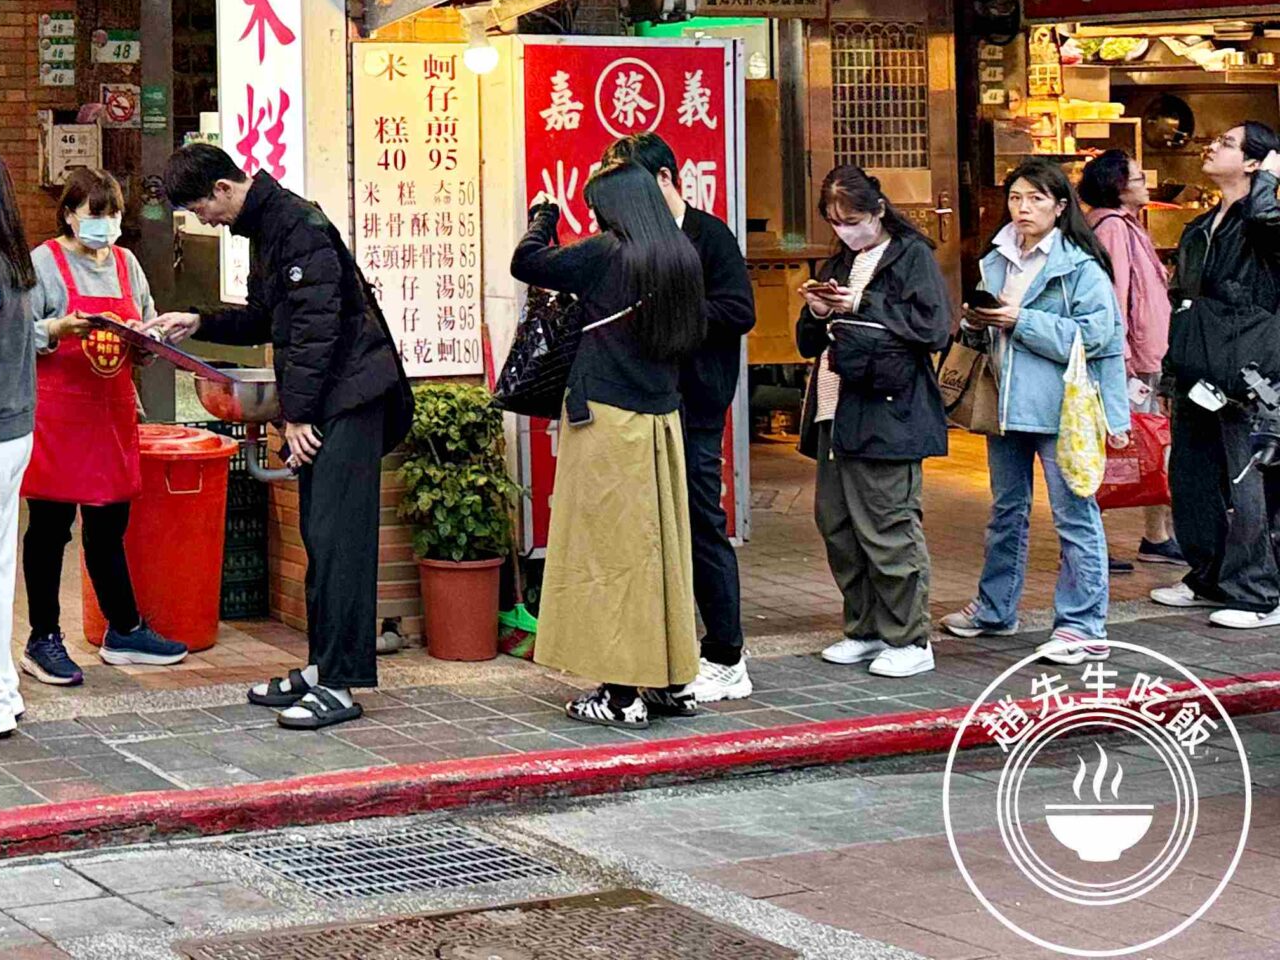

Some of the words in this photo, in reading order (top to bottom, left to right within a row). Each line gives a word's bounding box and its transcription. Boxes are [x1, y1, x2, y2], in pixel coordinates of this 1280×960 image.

[112, 44, 132, 59] 48
[423, 53, 459, 144] 蚵仔煎
[539, 70, 584, 131] 嘉
[677, 69, 718, 130] 義
[61, 134, 76, 144] 46
[377, 149, 407, 171] 40
[428, 149, 458, 171] 95
[458, 181, 475, 206] 50
[541, 158, 718, 234] 火飯
[363, 212, 453, 238] 排骨酥湯
[458, 212, 475, 238] 85
[365, 244, 454, 270] 菜頭排骨湯
[459, 243, 476, 269] 85
[458, 274, 474, 300] 95
[459, 305, 474, 330] 95
